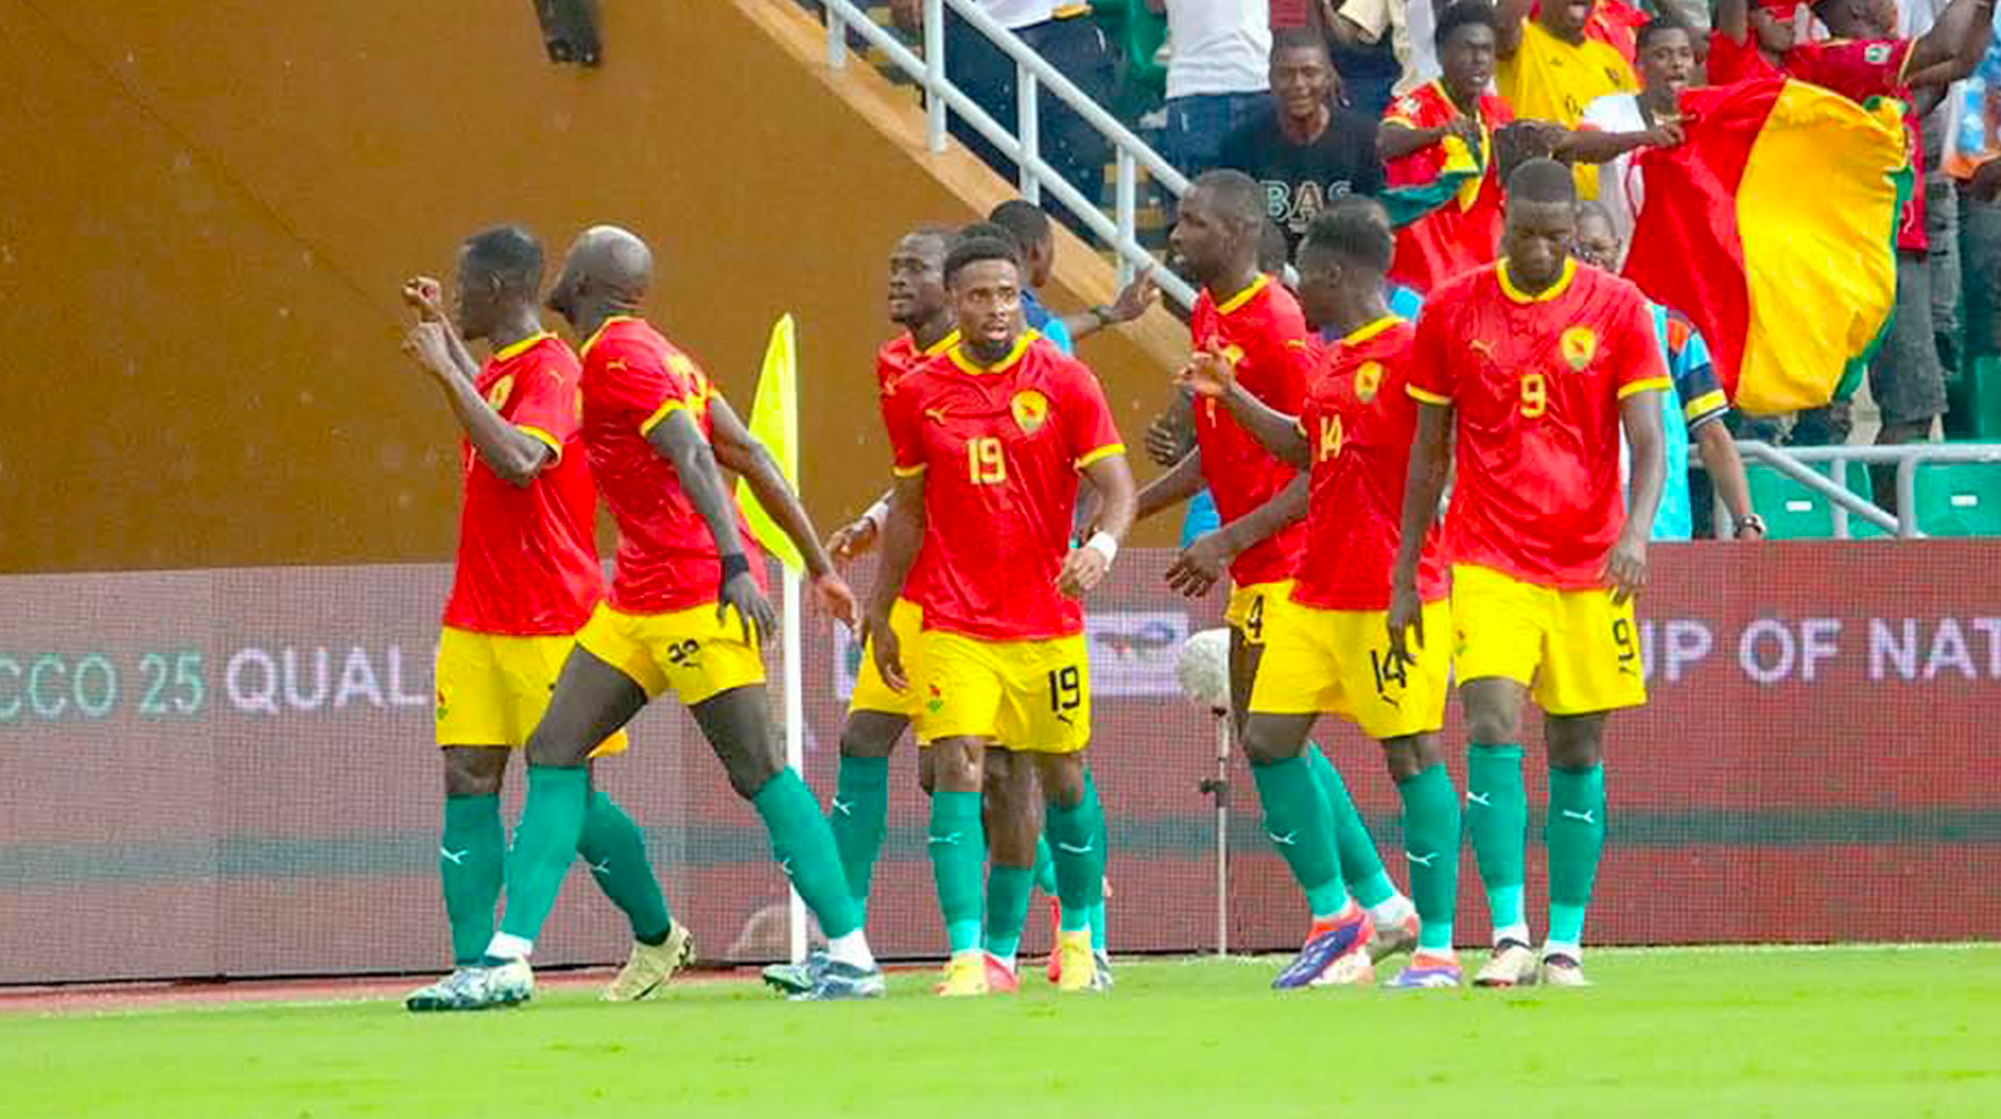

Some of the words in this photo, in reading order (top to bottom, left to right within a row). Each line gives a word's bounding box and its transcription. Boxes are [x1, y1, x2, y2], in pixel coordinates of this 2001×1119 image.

[1521, 374, 1546, 418] 9
[968, 437, 1006, 484] 19
[1320, 414, 1342, 462] 14
[1612, 618, 1634, 662] 9
[1738, 617, 1843, 684] OF
[1868, 617, 2001, 681] NAT
[0, 656, 115, 718] CCO
[139, 653, 205, 715] 25
[227, 646, 429, 714] QUAL
[1048, 666, 1080, 712] 19
[1370, 650, 1406, 693] 14
